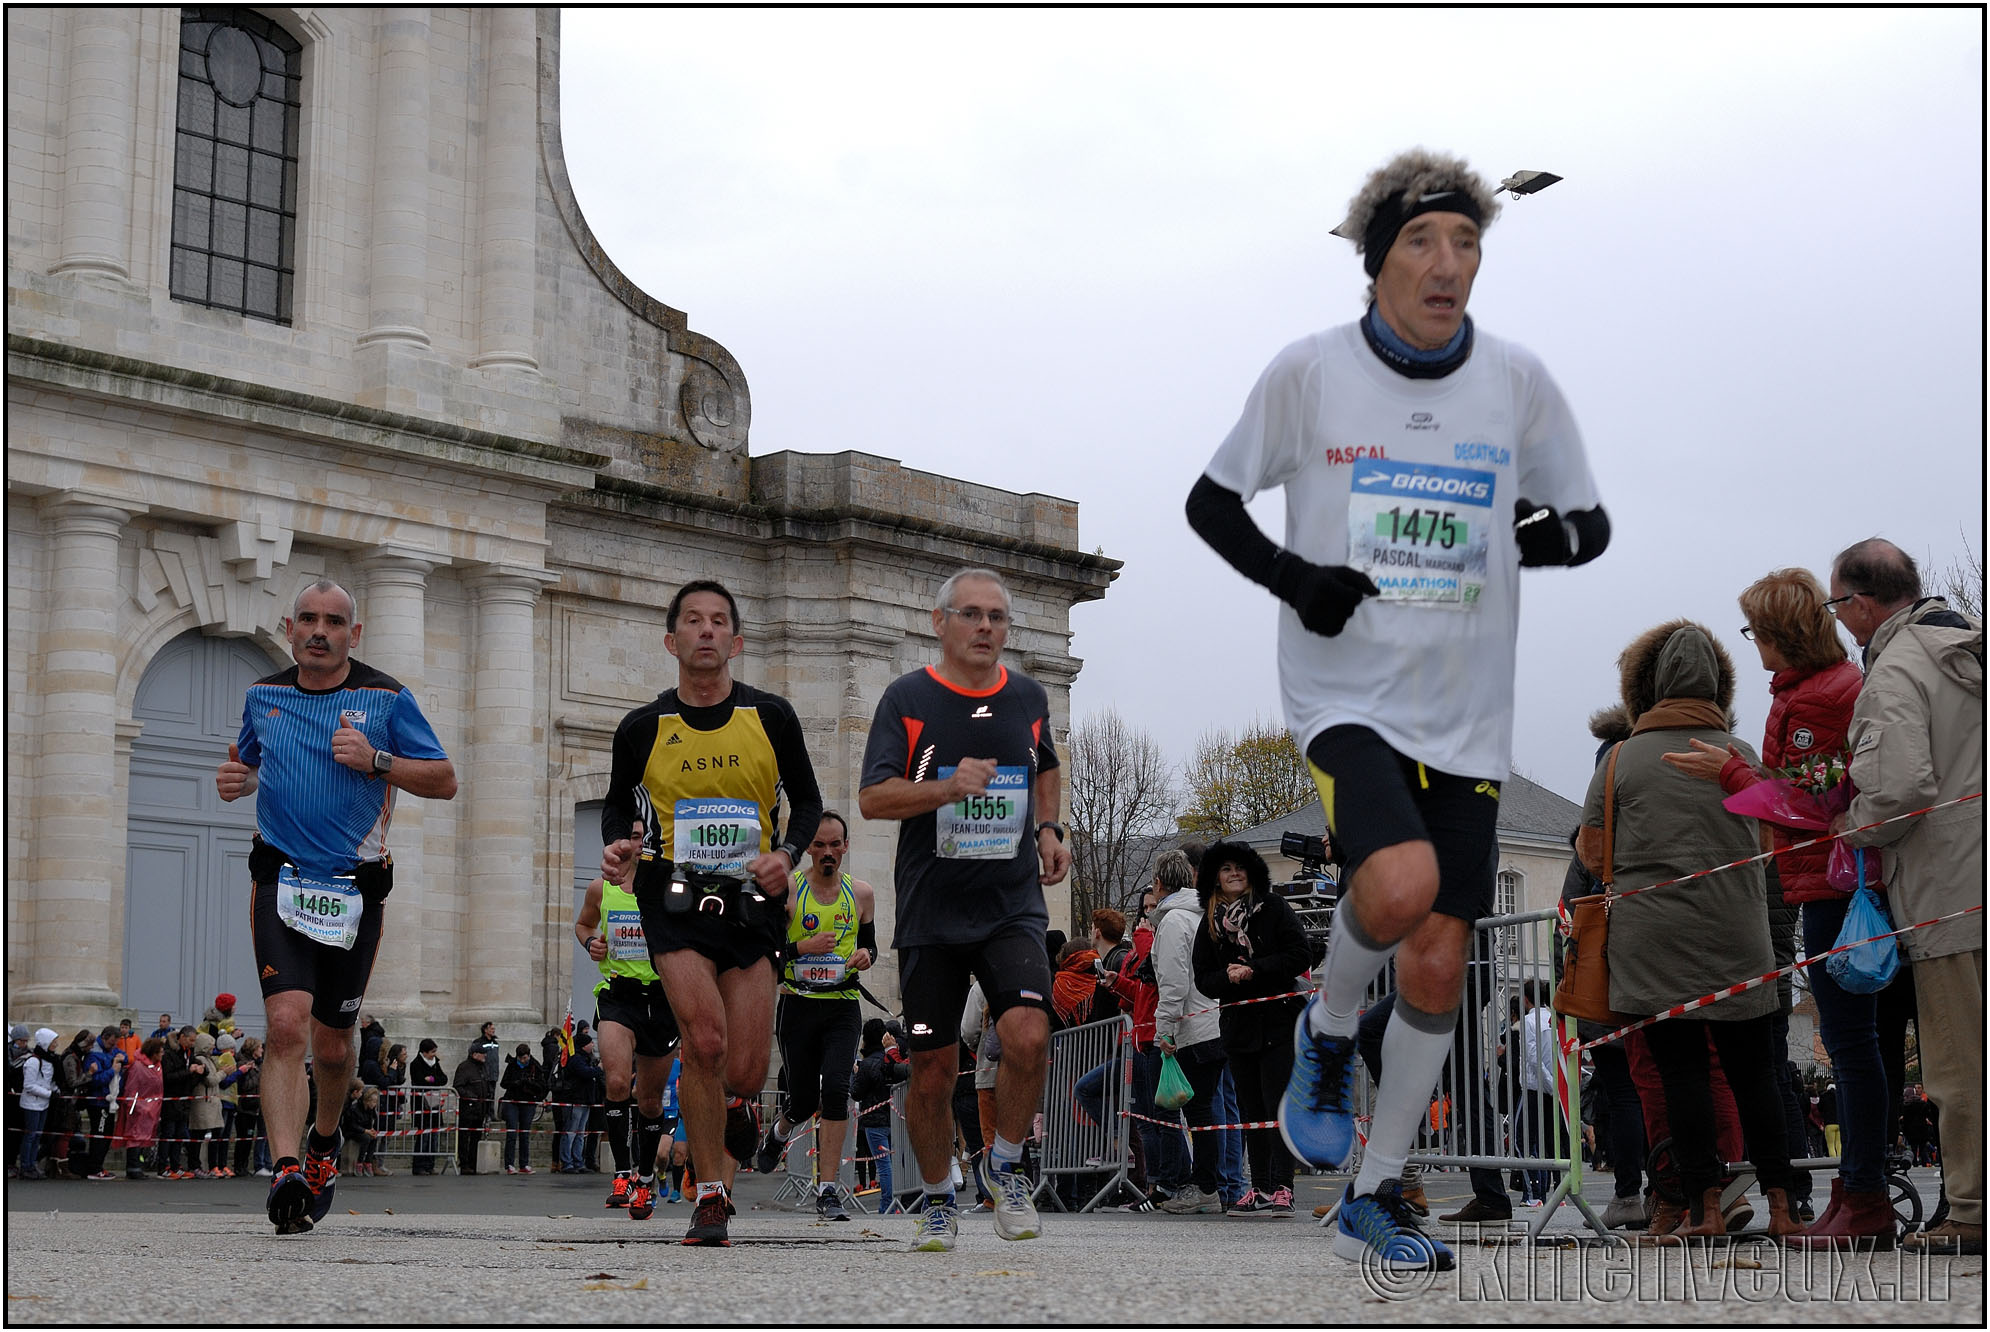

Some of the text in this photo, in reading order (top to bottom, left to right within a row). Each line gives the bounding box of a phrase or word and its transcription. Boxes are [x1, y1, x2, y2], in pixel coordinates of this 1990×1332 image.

[1326, 445, 1389, 466] PASCAL
[1454, 443, 1510, 466] DECATHLON
[1391, 474, 1489, 499] BROOKS
[1389, 506, 1456, 549] 1475
[1373, 548, 1421, 568] PASCAL
[1377, 576, 1457, 589] MARATHON
[990, 774, 1024, 784] OKS
[697, 805, 755, 815] BROOKS
[963, 796, 1006, 820] 1555
[697, 824, 739, 847] 1687
[950, 823, 991, 834] JEAN-LUC
[959, 838, 1010, 849] MARATHON
[688, 849, 726, 859] JEAN-LUC
[299, 894, 341, 917] 1465
[295, 910, 325, 926] PATRICK
[298, 921, 341, 935] MARATHON
[621, 926, 641, 939] 844
[810, 967, 828, 980] 621
